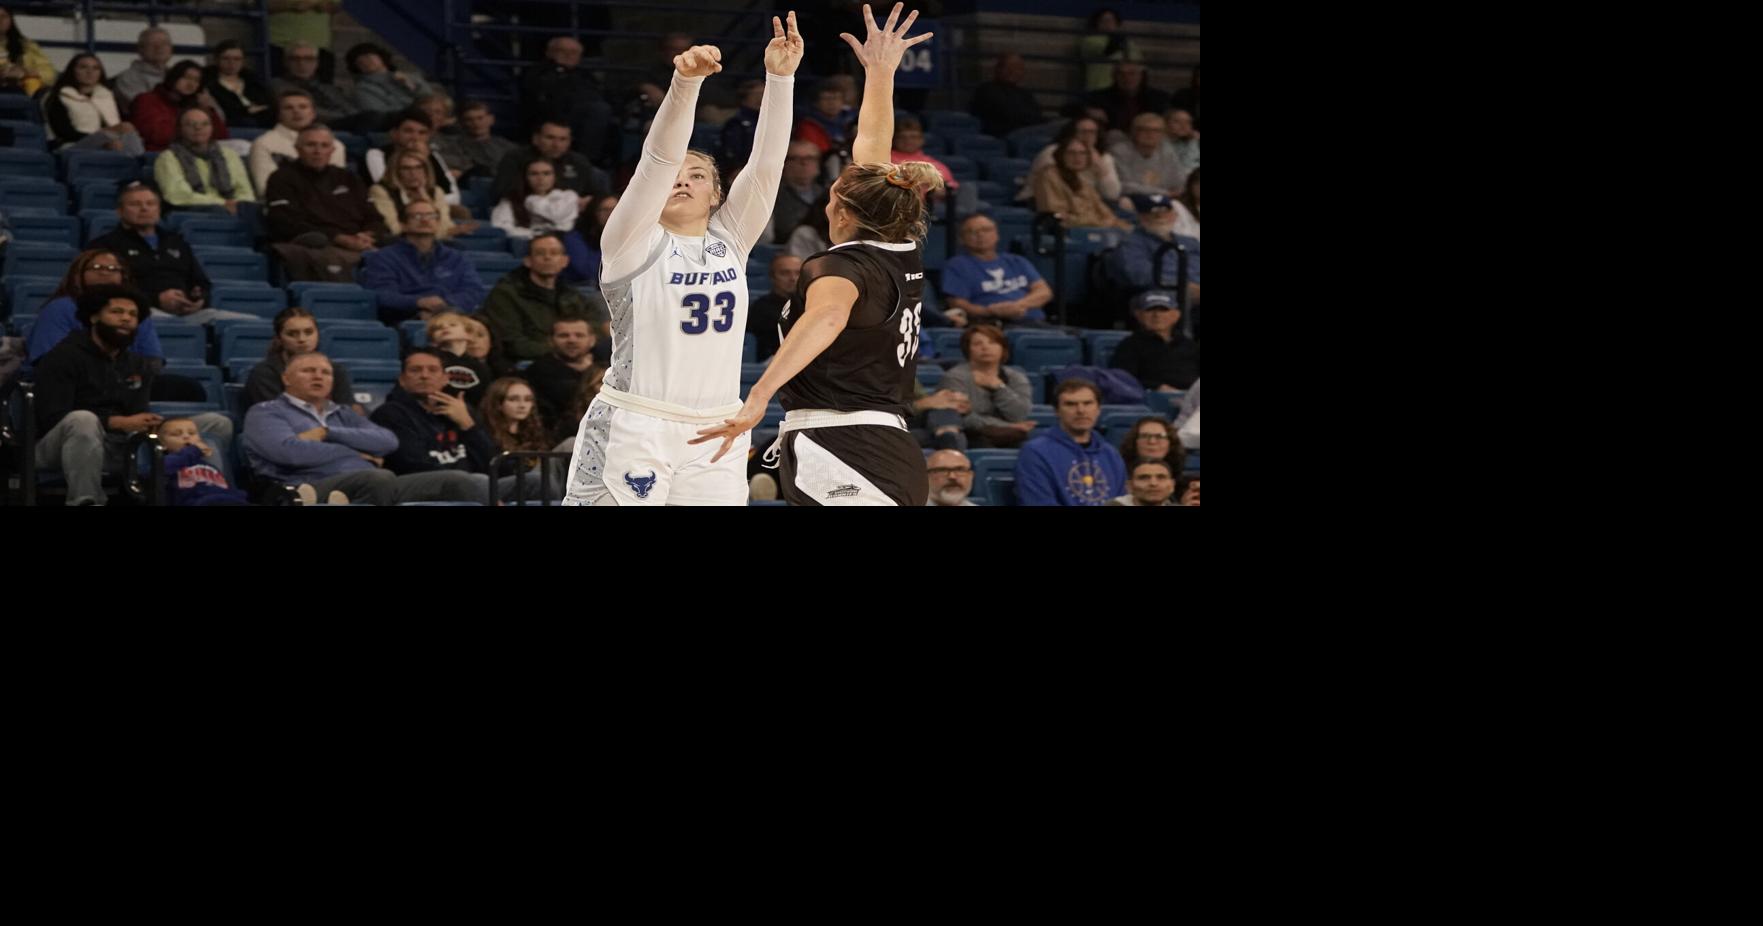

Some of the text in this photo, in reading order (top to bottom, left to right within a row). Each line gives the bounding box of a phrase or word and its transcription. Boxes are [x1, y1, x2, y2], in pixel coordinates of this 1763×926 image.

[900, 48, 932, 72] 04
[668, 267, 737, 286] BUFALO
[681, 290, 736, 335] 33
